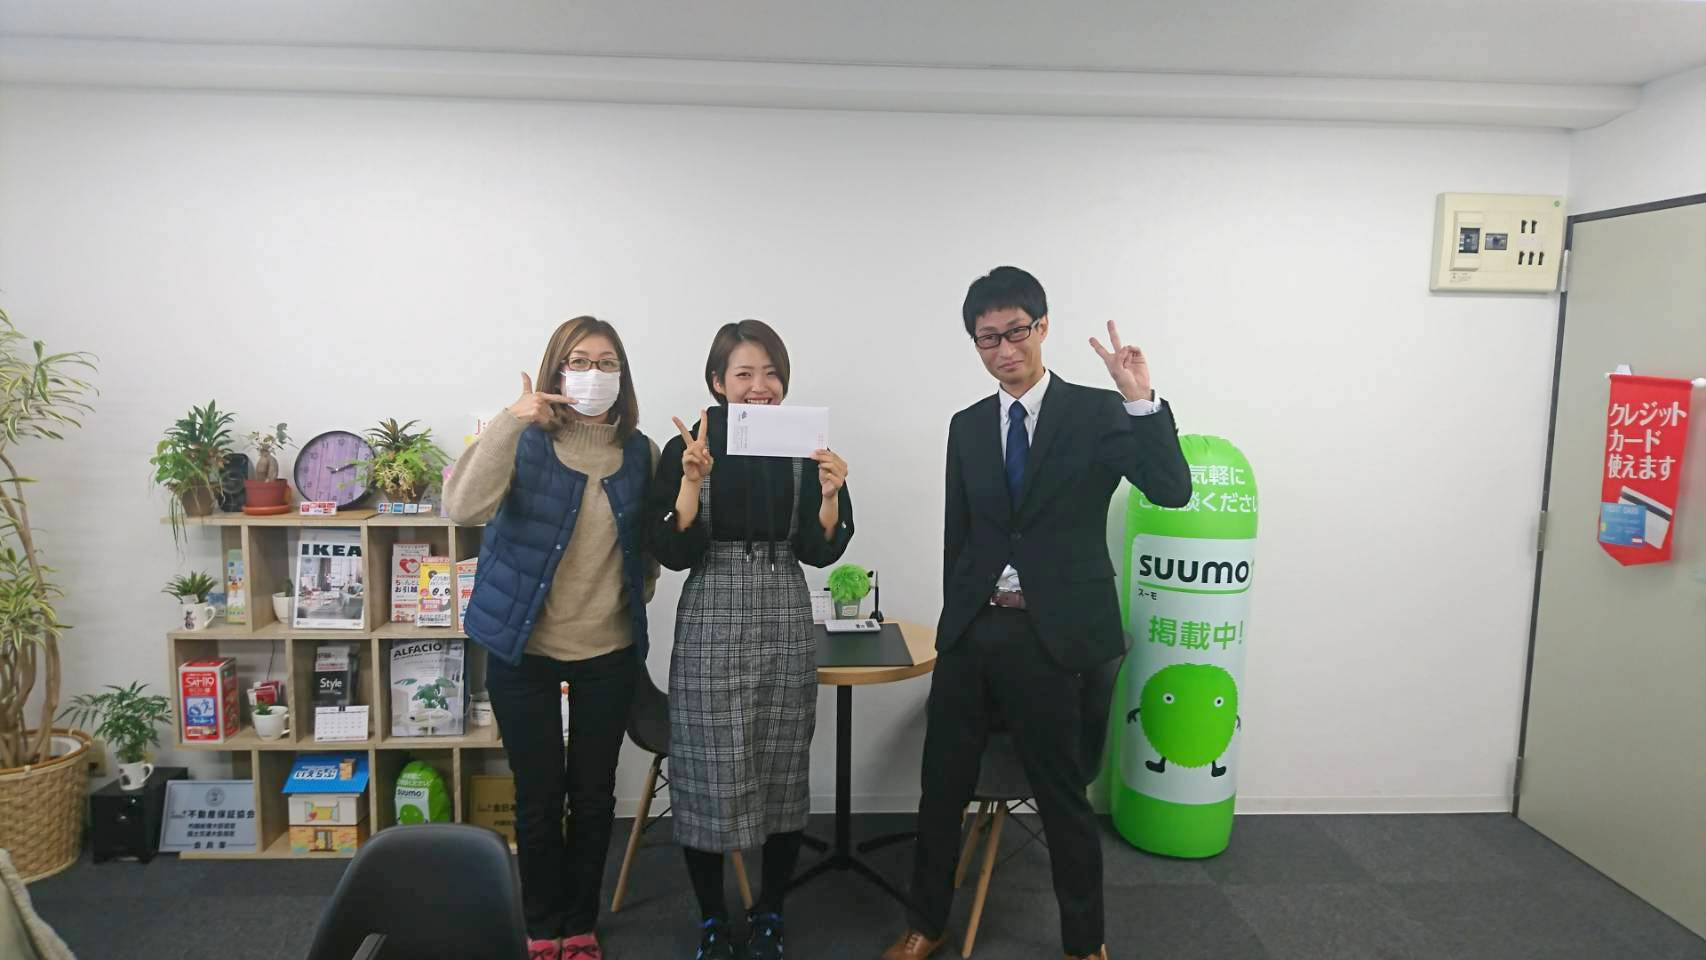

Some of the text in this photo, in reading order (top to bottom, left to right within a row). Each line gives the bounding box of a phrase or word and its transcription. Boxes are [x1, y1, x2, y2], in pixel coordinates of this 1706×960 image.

[1609, 401, 1687, 427] クレジット
[1609, 429, 1661, 453] カード
[1191, 464, 1246, 486] 気軽に
[1608, 453, 1676, 481] 使えます
[301, 543, 362, 557] IKEA
[1138, 588, 1157, 600] スーモ
[394, 643, 442, 658] ALFACIO
[320, 677, 343, 690] Style
